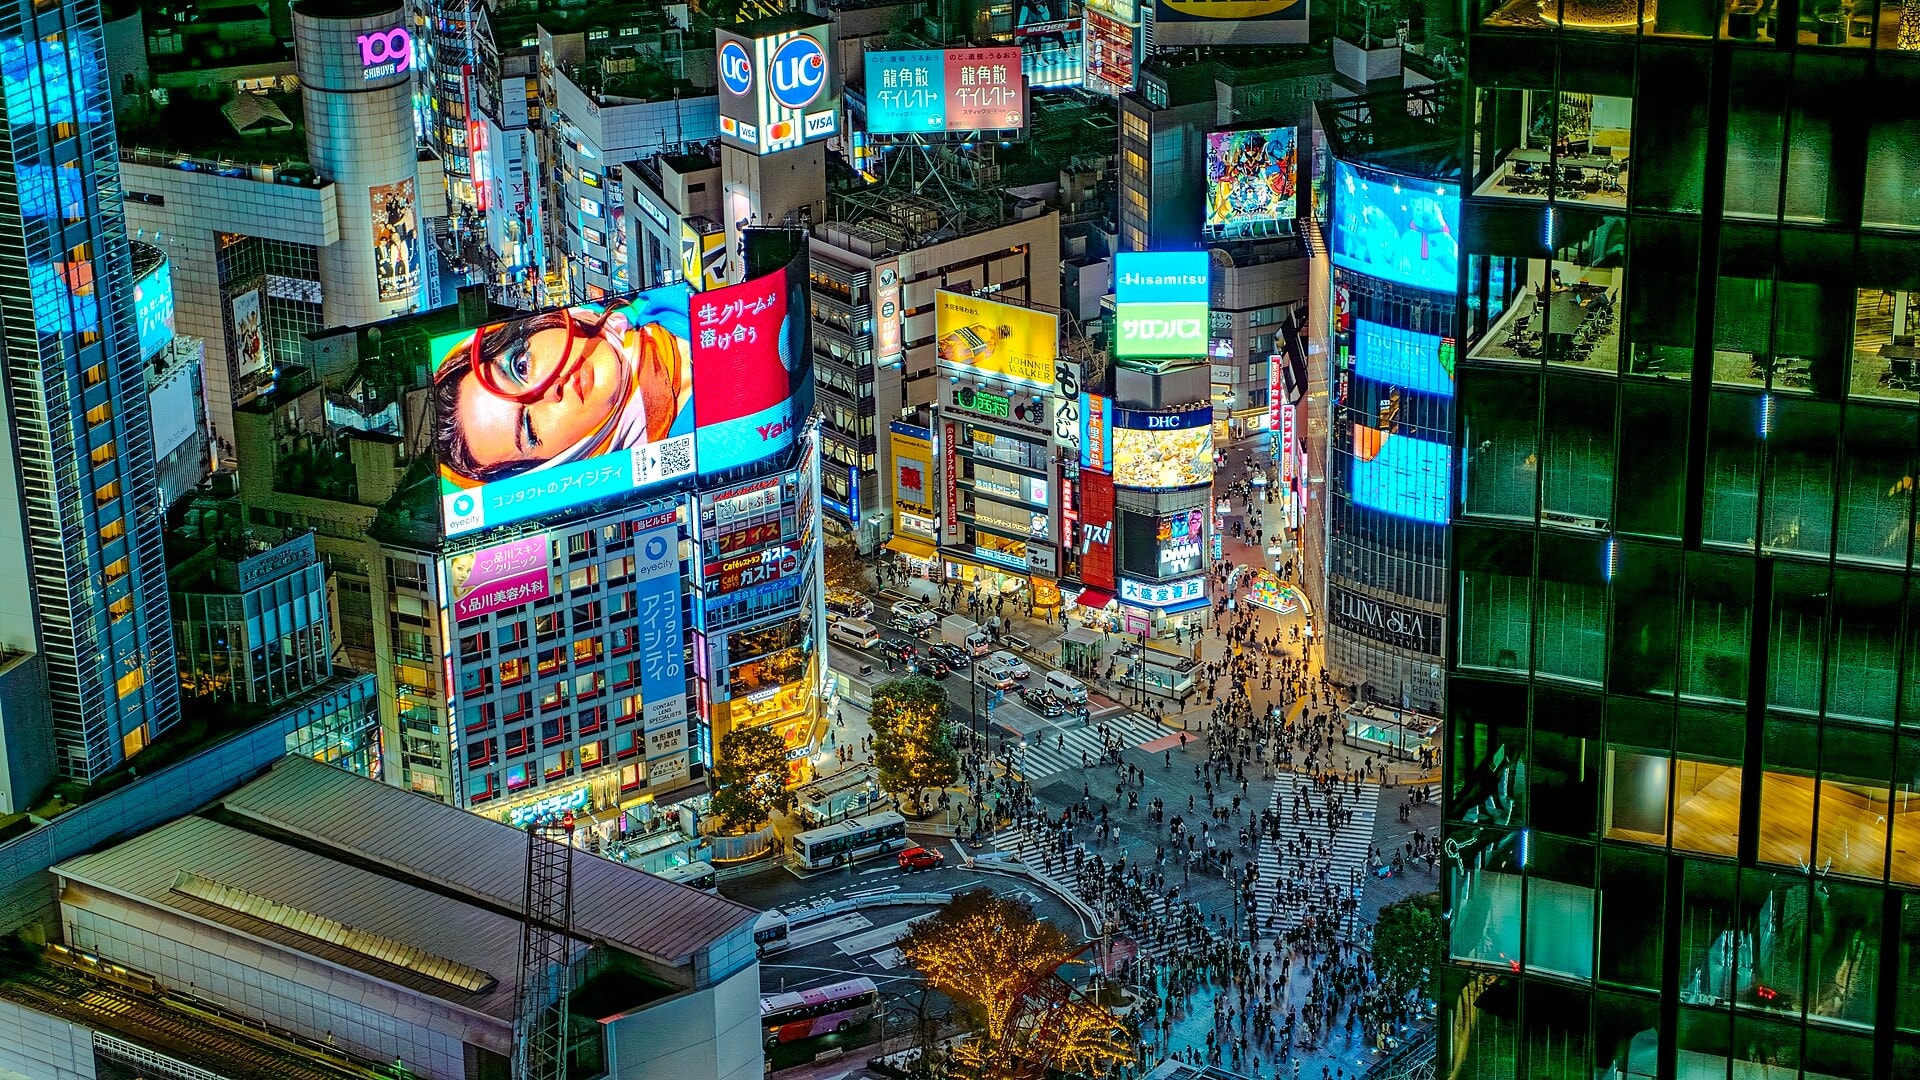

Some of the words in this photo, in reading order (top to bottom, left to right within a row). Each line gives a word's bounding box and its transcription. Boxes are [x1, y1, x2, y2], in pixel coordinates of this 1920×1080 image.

[1027, 22, 1070, 33] SKECHERS
[357, 28, 409, 72] 109
[363, 63, 395, 79] SHIBUYA
[723, 54, 748, 83] UC
[776, 53, 821, 90] UC
[883, 66, 929, 88] 龍角散
[961, 65, 1007, 86] 龍角散
[877, 87, 938, 109] ダイレクト
[955, 86, 1016, 107] ダイレクト
[741, 127, 755, 138] VISA
[808, 116, 833, 131] VISA
[1119, 273, 1206, 285] Hisamitsu
[698, 293, 776, 325] 生クリームが
[700, 324, 758, 349] 溶け合う
[1122, 319, 1202, 340] サロンパス
[1009, 356, 1050, 372] JOHNNIE
[1009, 364, 1050, 380] WALKER
[978, 398, 1008, 418] 西村
[1055, 363, 1080, 448] もんじゃ
[1148, 415, 1180, 427] DHC
[1089, 399, 1101, 467] 三千里薬品
[493, 465, 624, 509] コンタクトのアイシティ
[449, 515, 481, 530] eyecity
[637, 512, 673, 531] 当ビル5F
[702, 510, 715, 521] 9F
[494, 542, 542, 563] 品川スキン
[761, 546, 792, 563] ガスト
[1161, 543, 1200, 563] DMM
[495, 555, 537, 575] クリニック
[641, 558, 674, 574] eyecity
[741, 564, 777, 586] ガスト
[1171, 558, 1190, 573] TV
[705, 580, 719, 592] 7F
[722, 574, 739, 585] Café
[469, 580, 544, 612] 品川美容外科
[1126, 582, 1198, 601] 大盛堂書店
[1340, 592, 1384, 629] LUNA
[1386, 610, 1426, 640] SEA
[643, 594, 663, 680] アイシティ
[664, 590, 679, 677] コンタクトの
[652, 700, 677, 712] CONTACT
[658, 708, 672, 716] LENS
[649, 710, 682, 724] SPECIALISTS
